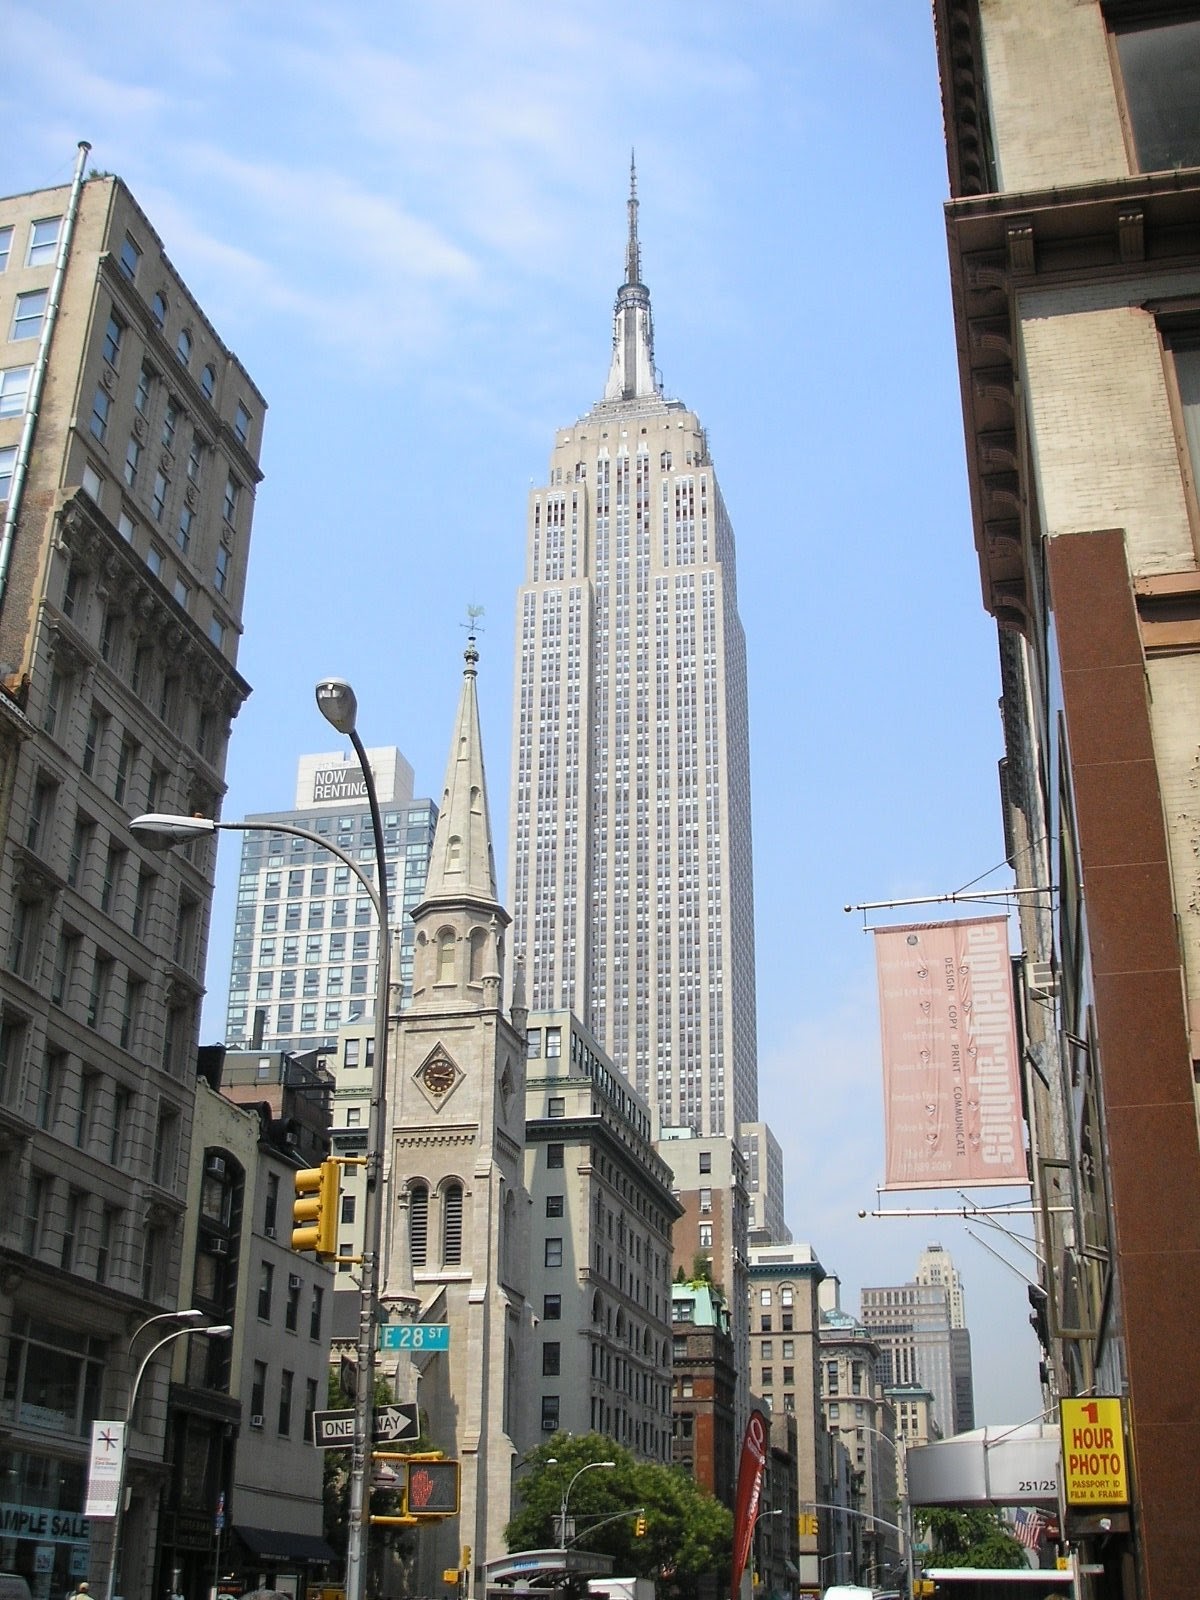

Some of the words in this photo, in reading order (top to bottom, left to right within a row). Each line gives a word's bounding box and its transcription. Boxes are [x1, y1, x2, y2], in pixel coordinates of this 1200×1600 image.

[316, 770, 347, 785] NOW
[315, 782, 369, 799] RENTING
[944, 957, 956, 992] DESIGN
[948, 1005, 959, 1030] COPY
[951, 1044, 962, 1073] PRINT
[953, 1086, 966, 1157] COMMUNICATE
[384, 1327, 394, 1347] E
[400, 1327, 424, 1347] 28
[428, 1327, 443, 1339] ST
[1081, 1402, 1099, 1424] 1
[325, 1421, 353, 1436] ONE
[1072, 1427, 1114, 1449] HOUR
[1069, 1453, 1121, 1475] PHOTO
[1070, 1490, 1087, 1498] FILM
[1098, 1490, 1124, 1498] FRAME
[1072, 1480, 1109, 1488] PASSPORT
[1113, 1480, 1120, 1488] ID
[50, 1515, 90, 1539] SALE
